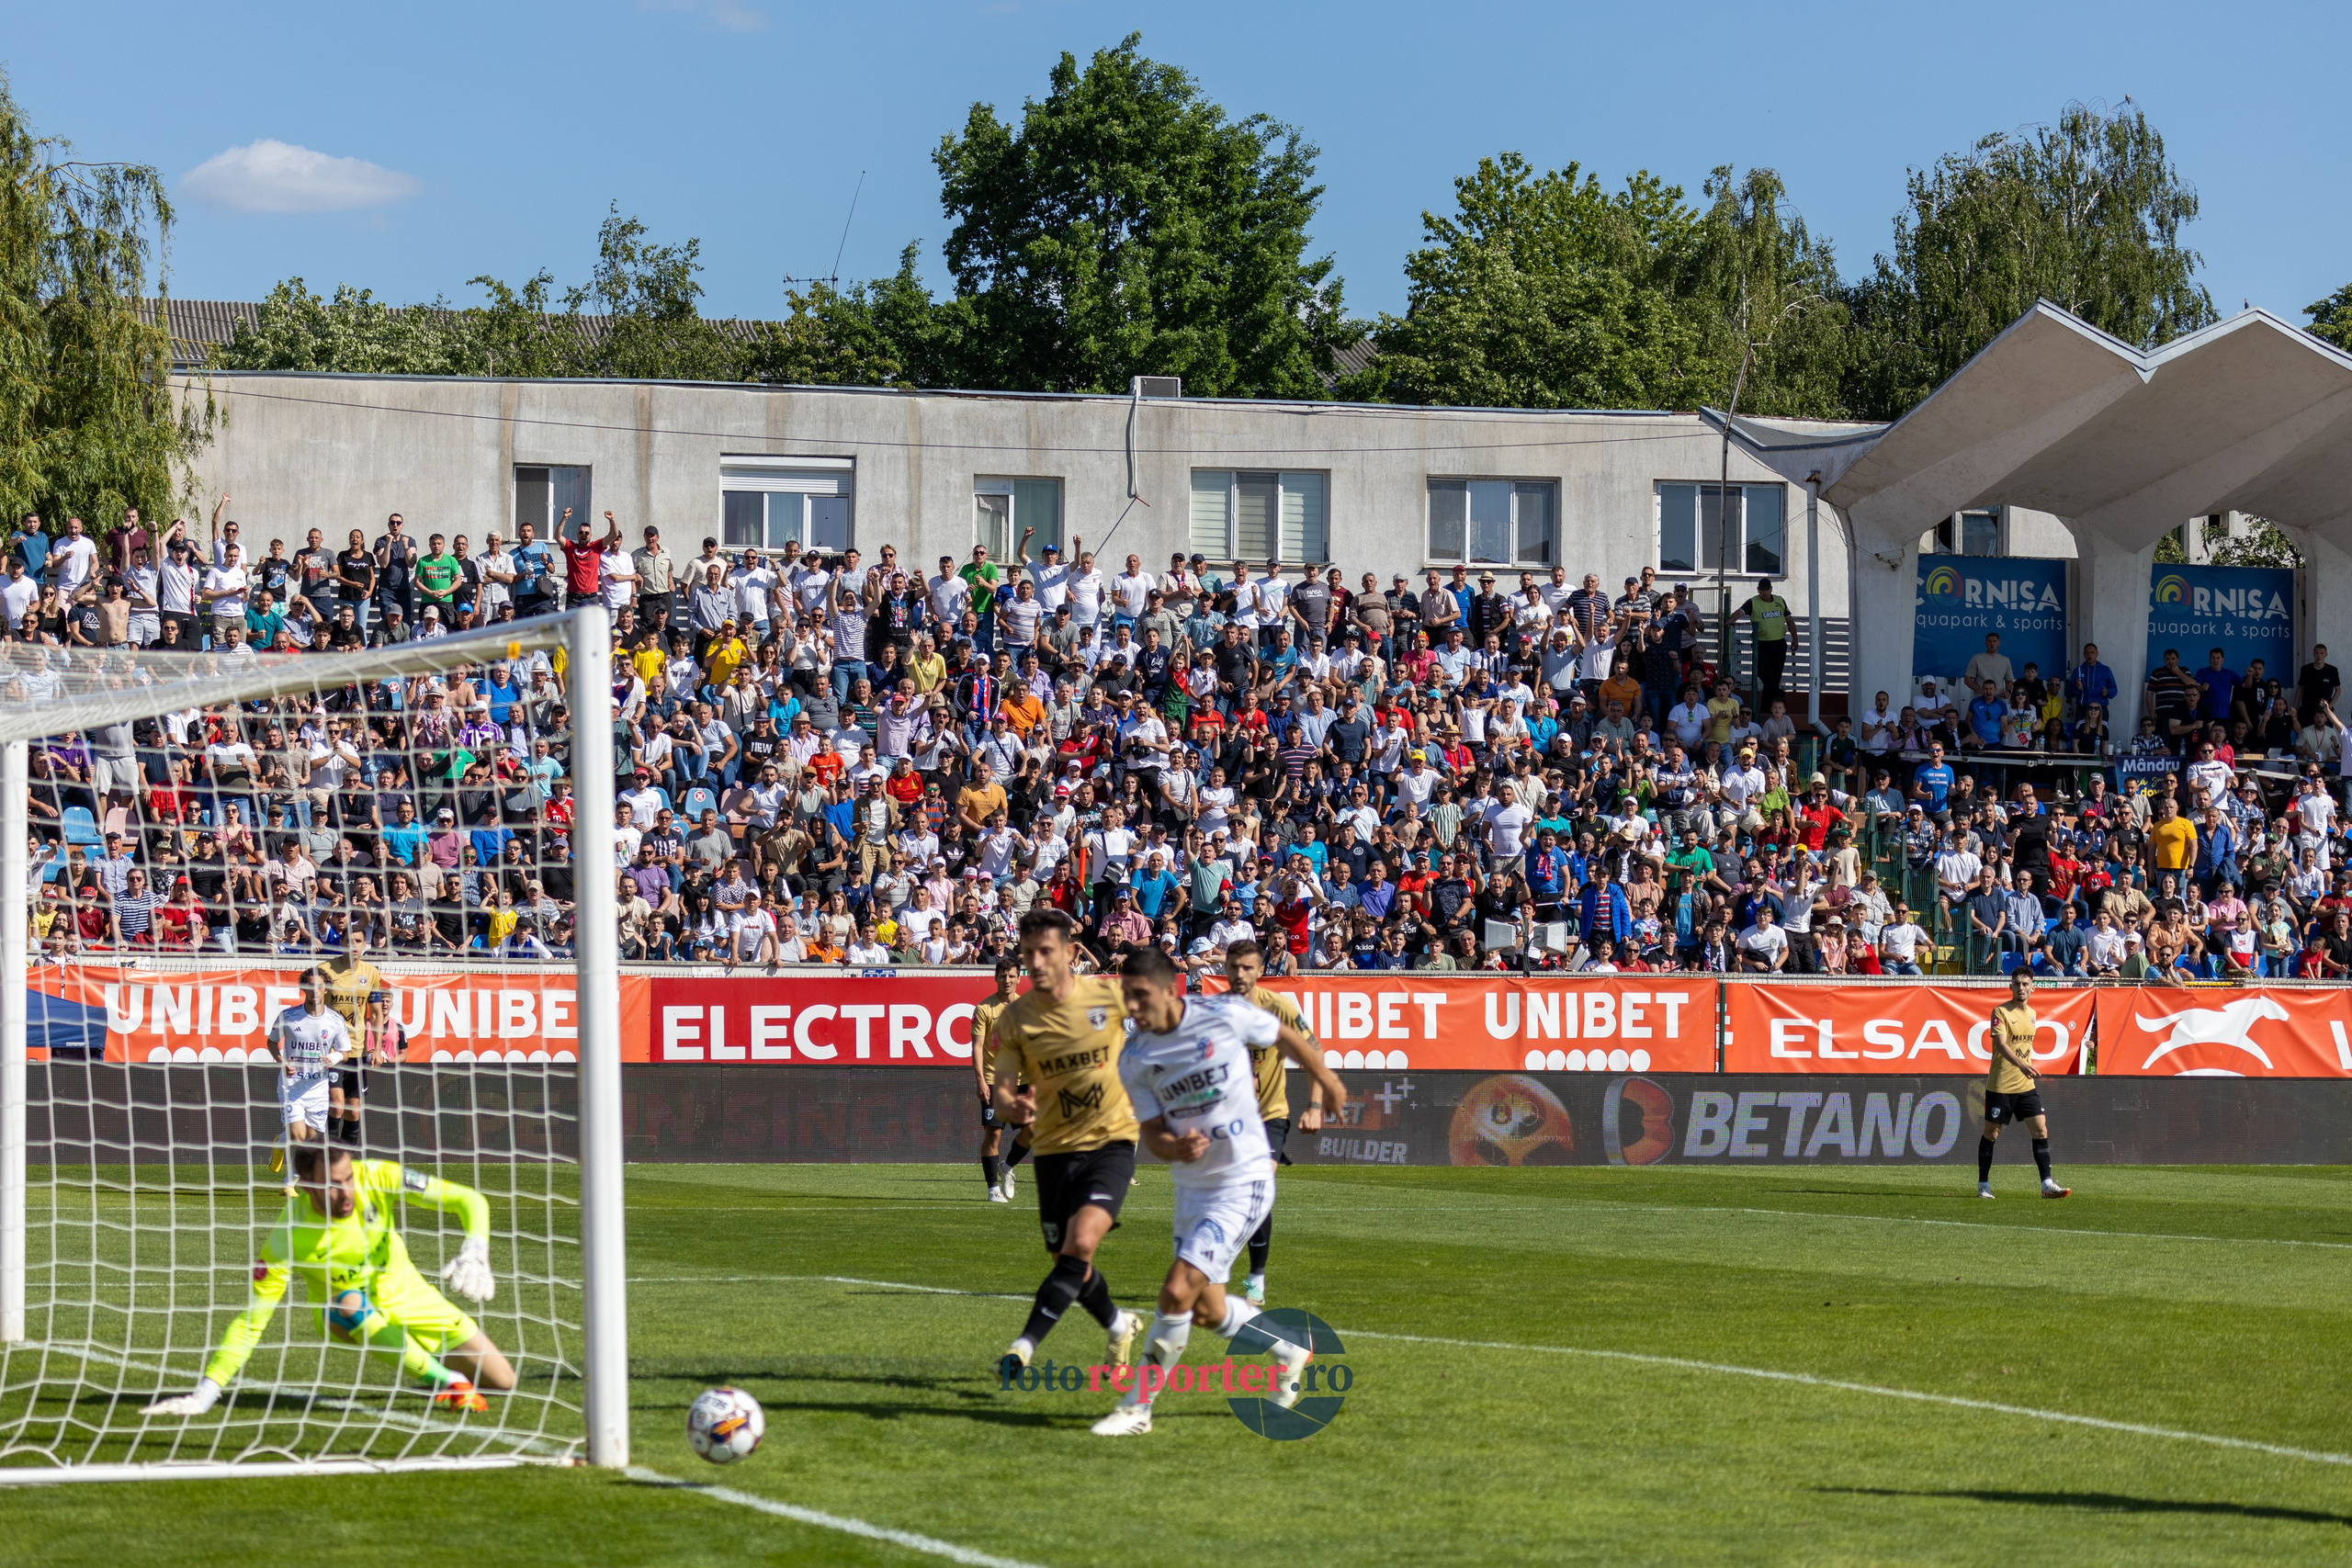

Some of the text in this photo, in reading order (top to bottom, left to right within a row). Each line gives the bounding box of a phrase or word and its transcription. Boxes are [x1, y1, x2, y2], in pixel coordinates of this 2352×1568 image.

[1916, 613, 2064, 633] quapark & sports
[2148, 620, 2290, 641] quapark & sports
[751, 741, 773, 754] NEW
[2122, 758, 2180, 773] Mândru
[104, 984, 301, 1036] UNIBE
[331, 994, 366, 1006] MAXBET
[390, 987, 618, 1040] UNIBE
[1280, 992, 1447, 1040] NIBET
[1485, 992, 1690, 1040] UNIBET
[291, 1041, 327, 1051] UNIBET
[662, 1003, 974, 1061] ELECTRO
[2011, 1034, 2034, 1043] MAXBE
[1037, 1045, 1109, 1076] MAXBET
[1161, 1061, 1229, 1101] UNIBET
[1683, 1090, 1961, 1159] BETANO
[1318, 1136, 1409, 1164] BUILDER
